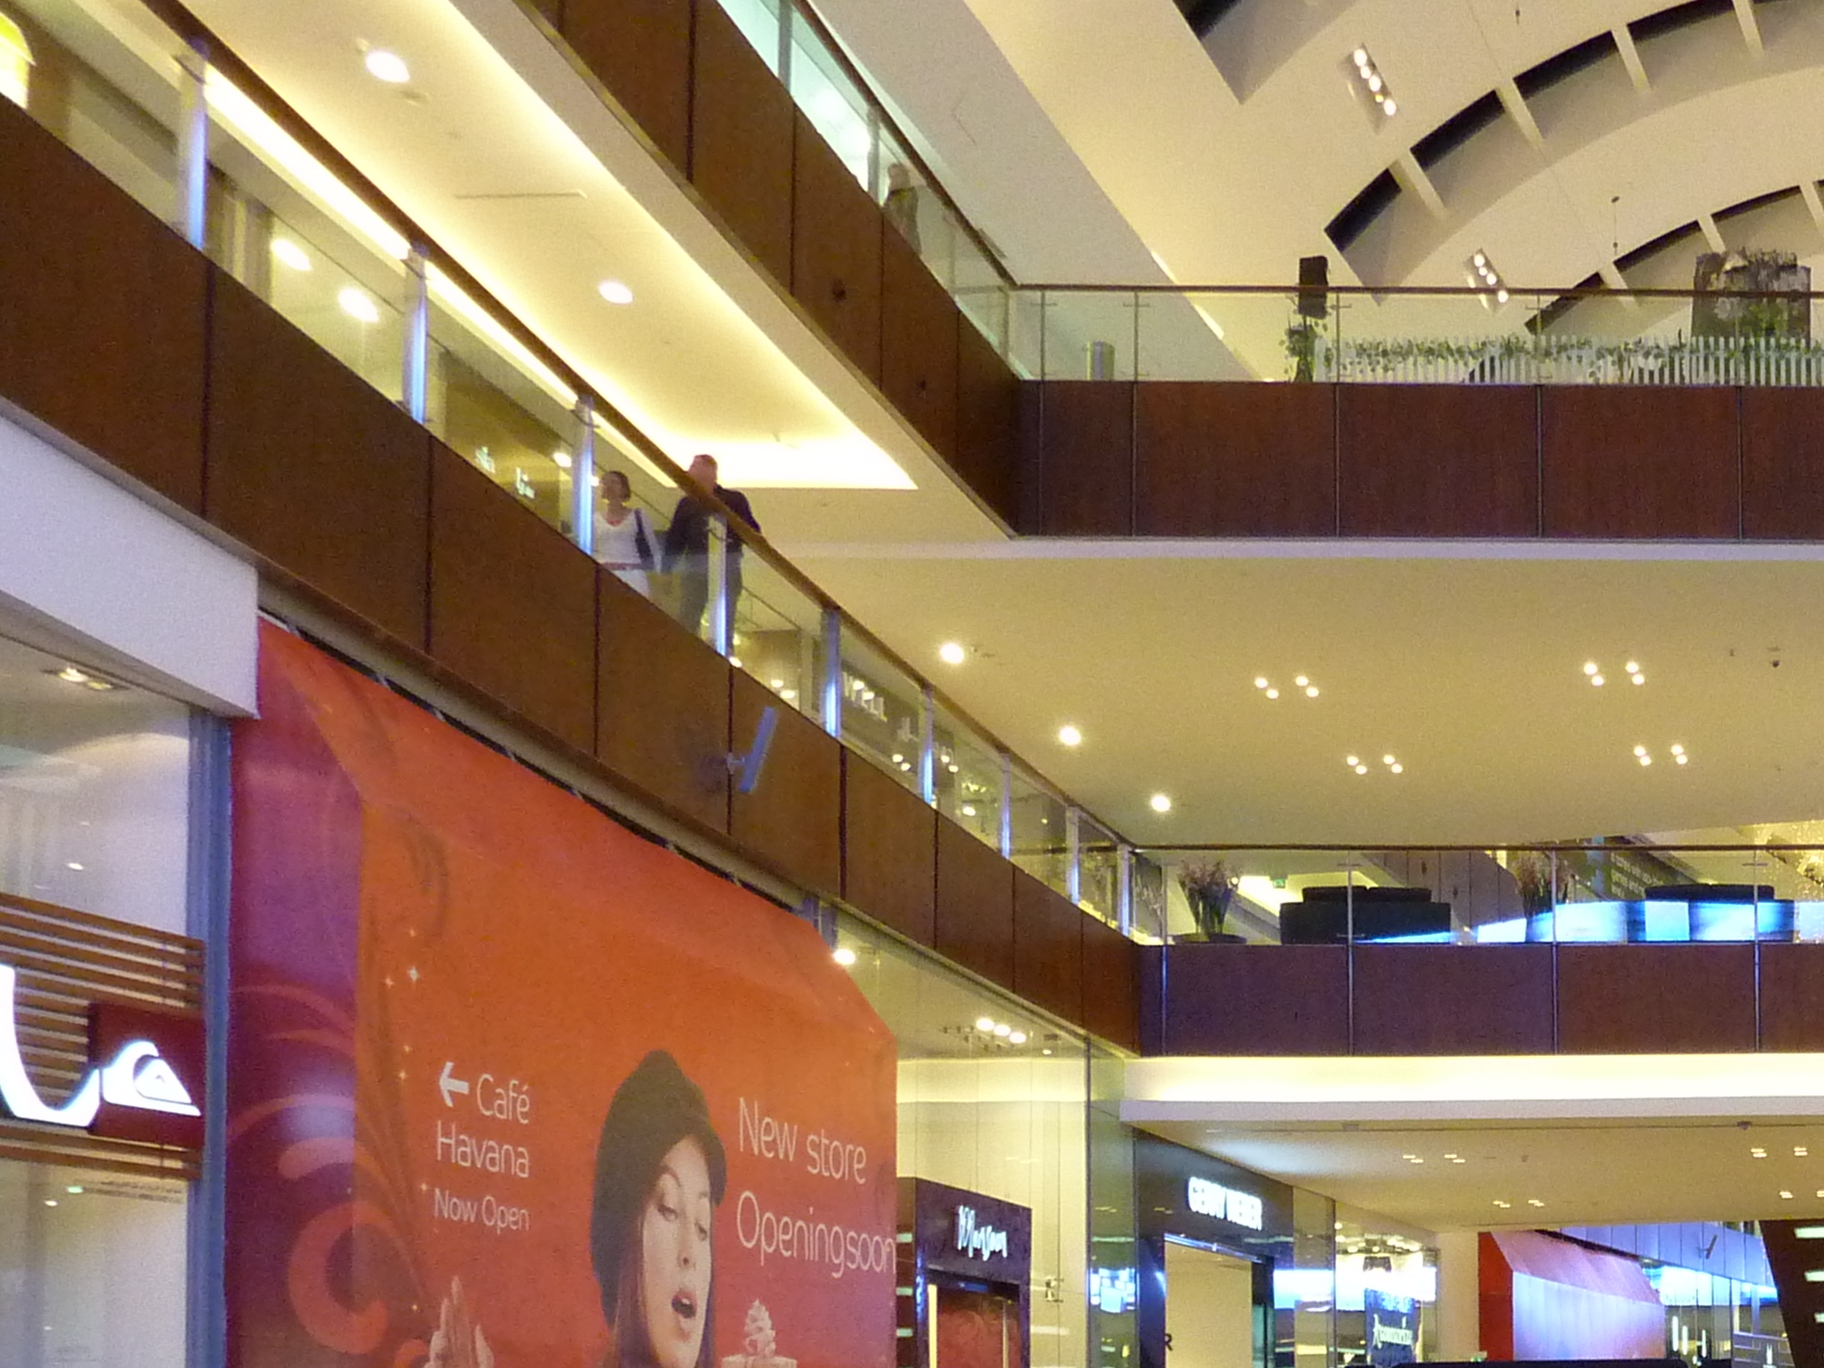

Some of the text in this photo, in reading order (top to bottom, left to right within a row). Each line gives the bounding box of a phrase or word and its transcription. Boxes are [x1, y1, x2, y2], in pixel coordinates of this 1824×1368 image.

[476, 1073, 531, 1125] Café
[436, 1119, 531, 1179] Havana
[739, 1096, 867, 1185] New store
[433, 1187, 530, 1235] Now Open
